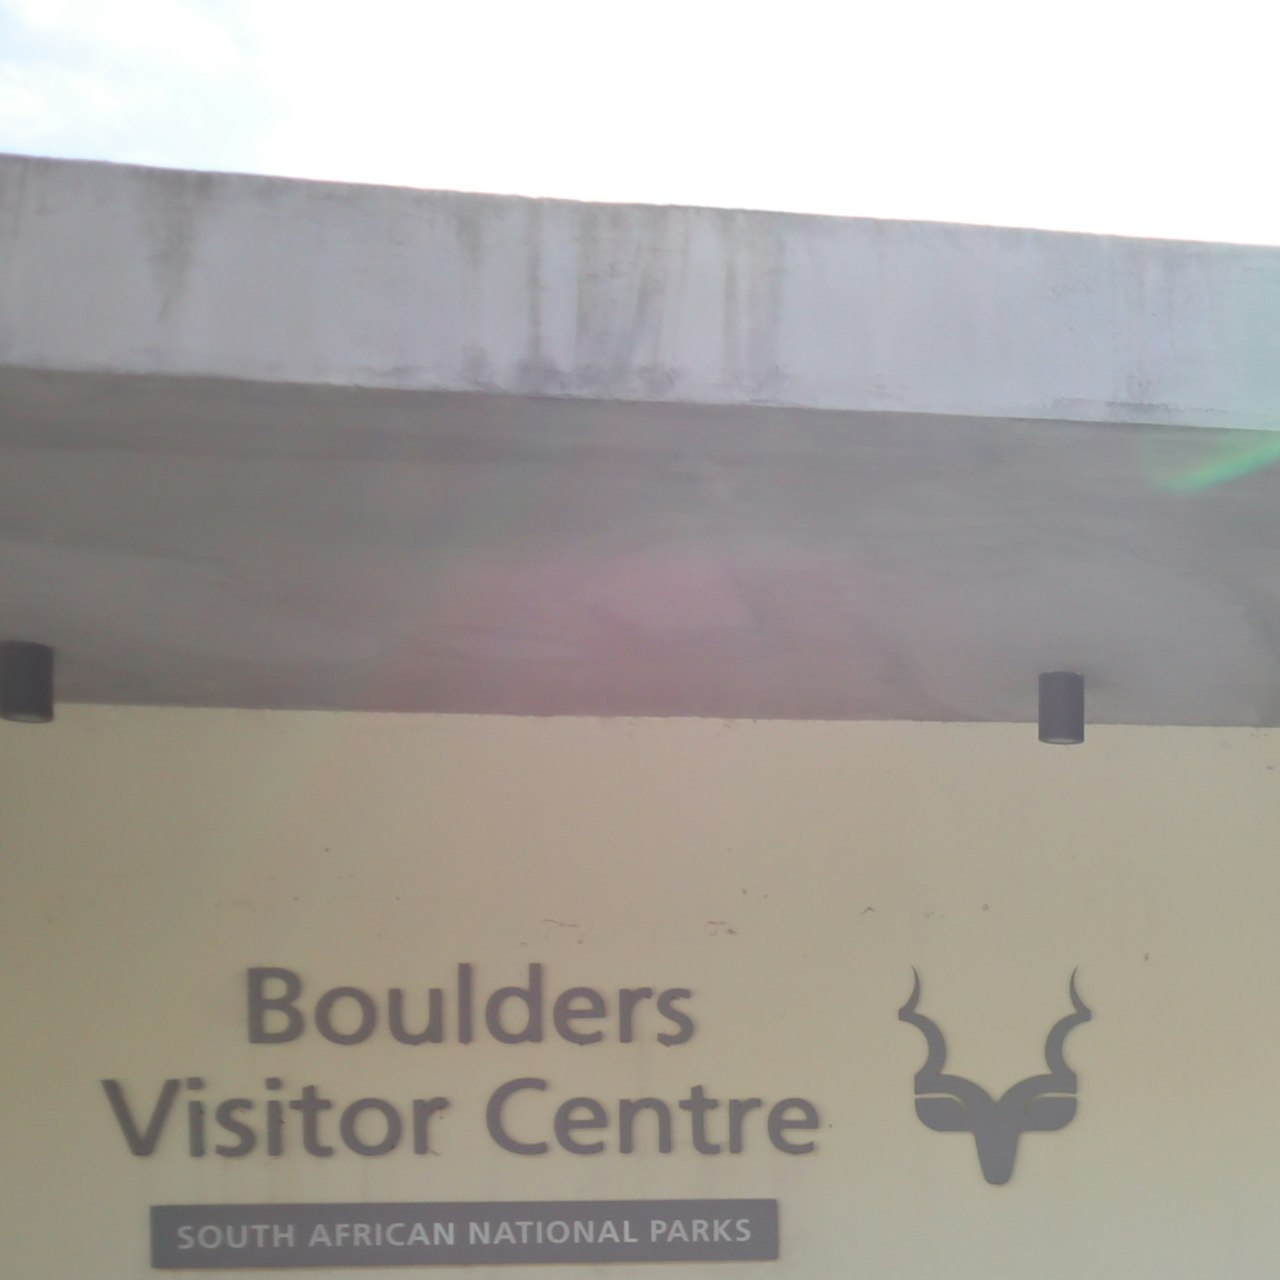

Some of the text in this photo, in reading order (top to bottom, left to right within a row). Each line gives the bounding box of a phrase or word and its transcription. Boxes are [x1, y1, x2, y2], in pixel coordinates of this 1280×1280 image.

[245, 962, 696, 1048] Boulders
[101, 1076, 821, 1159] Visitor Centre
[176, 1218, 752, 1250] SOUTH AFRICAN NATIONAL PARKS
